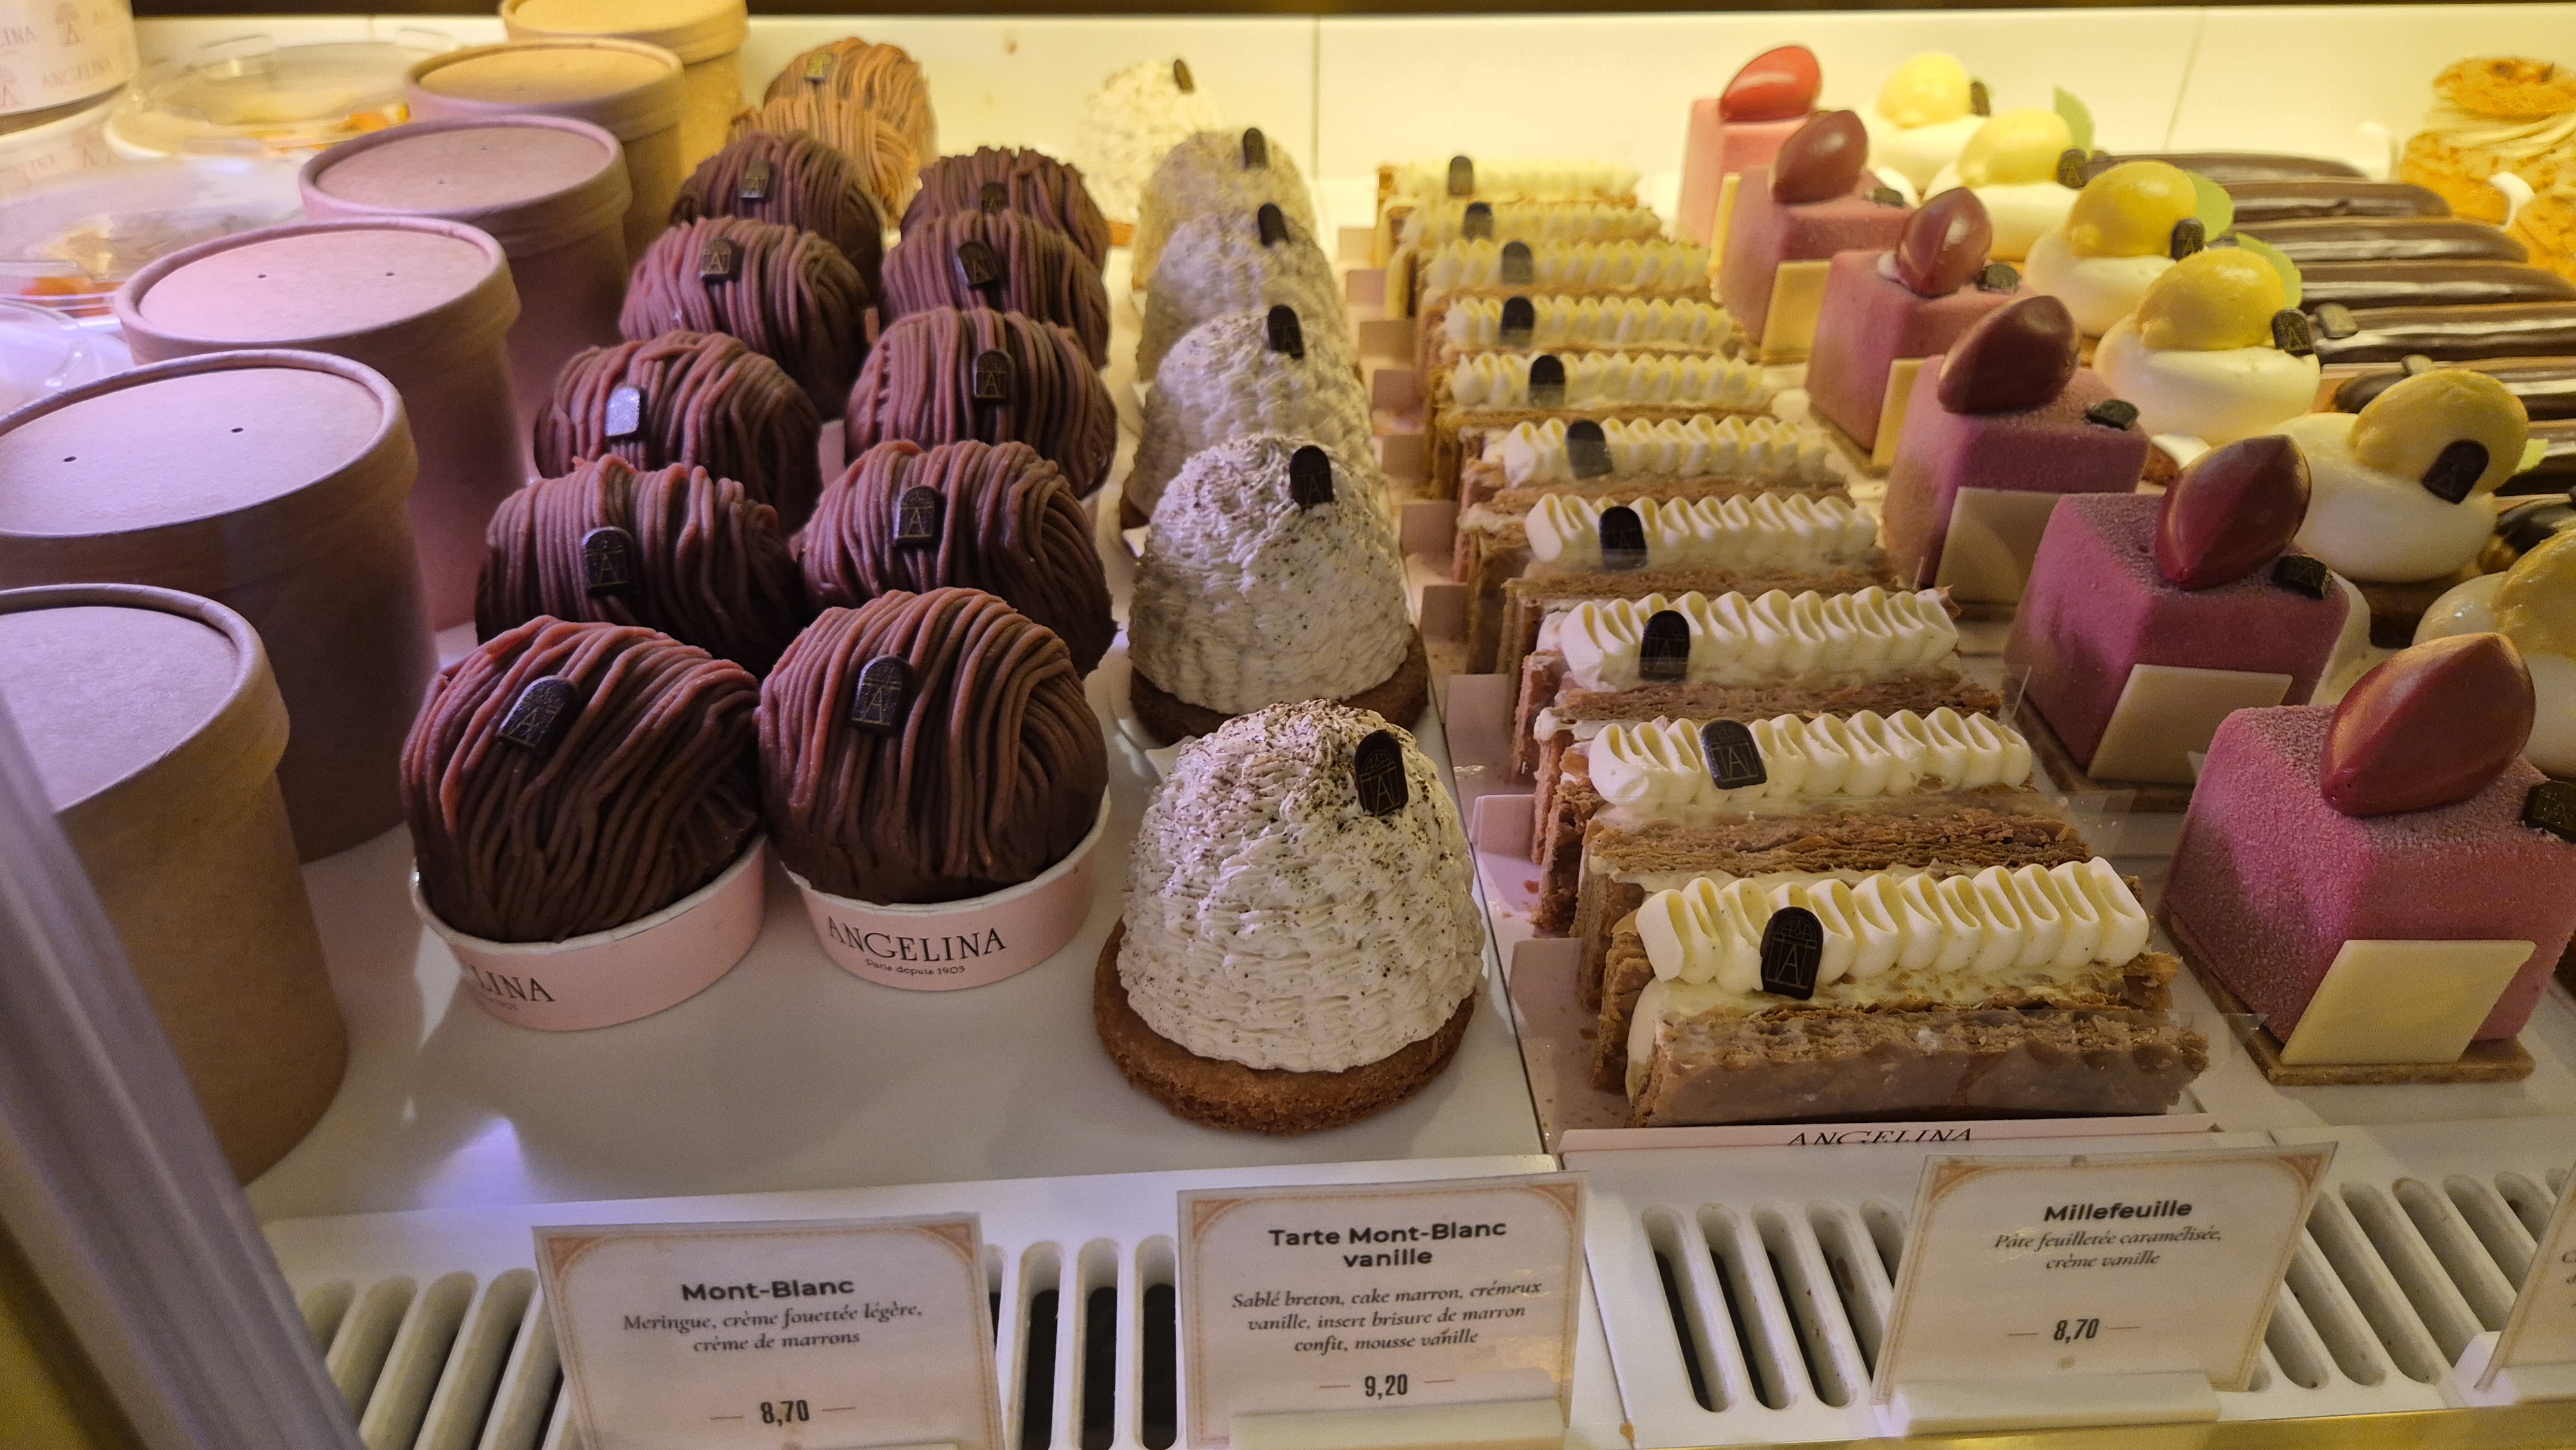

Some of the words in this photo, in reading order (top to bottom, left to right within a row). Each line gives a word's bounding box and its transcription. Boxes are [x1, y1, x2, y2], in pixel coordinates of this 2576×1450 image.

[828, 916, 1007, 962] ANGELINA
[938, 965, 965, 975] 1903
[1788, 1127, 1972, 1146] ANGELINA
[2043, 1200, 2192, 1222] Millefeuille
[1267, 1229, 1341, 1247] Tarte
[1349, 1221, 1507, 1245] Mont-Blanc
[2036, 1230, 2116, 1252] feuilletée
[2119, 1225, 2222, 1245] caramélisée,
[1342, 1248, 1434, 1268] vanille
[2046, 1254, 2098, 1270] crème
[2101, 1250, 2161, 1268] vanille
[681, 1279, 855, 1302] Mont-Blanc
[1232, 1290, 1280, 1308] Sablé
[1285, 1290, 1345, 1307] breton,
[1351, 1288, 1390, 1304] cake
[1395, 1288, 1464, 1303] marron,
[1470, 1280, 1542, 1297] crémeux
[623, 1315, 717, 1335] Meringue,
[723, 1310, 778, 1328] crème
[782, 1304, 858, 1329] fouettée
[864, 1301, 923, 1323] légère,
[1248, 1313, 1311, 1331] vanille,
[1318, 1315, 1367, 1329] insert
[1372, 1311, 1432, 1327] brisure
[1437, 1307, 1457, 1323] de
[1463, 1307, 1526, 1321] marron
[2052, 1318, 2101, 1344] 8,70
[694, 1336, 749, 1353] crème
[753, 1333, 775, 1350] de
[782, 1330, 860, 1348] marrons
[1294, 1335, 1349, 1357] confit,
[1355, 1337, 1416, 1350] mousse
[1421, 1328, 1479, 1347] vanille
[1363, 1373, 1408, 1400] 9,20
[759, 1399, 810, 1428] 8,70
